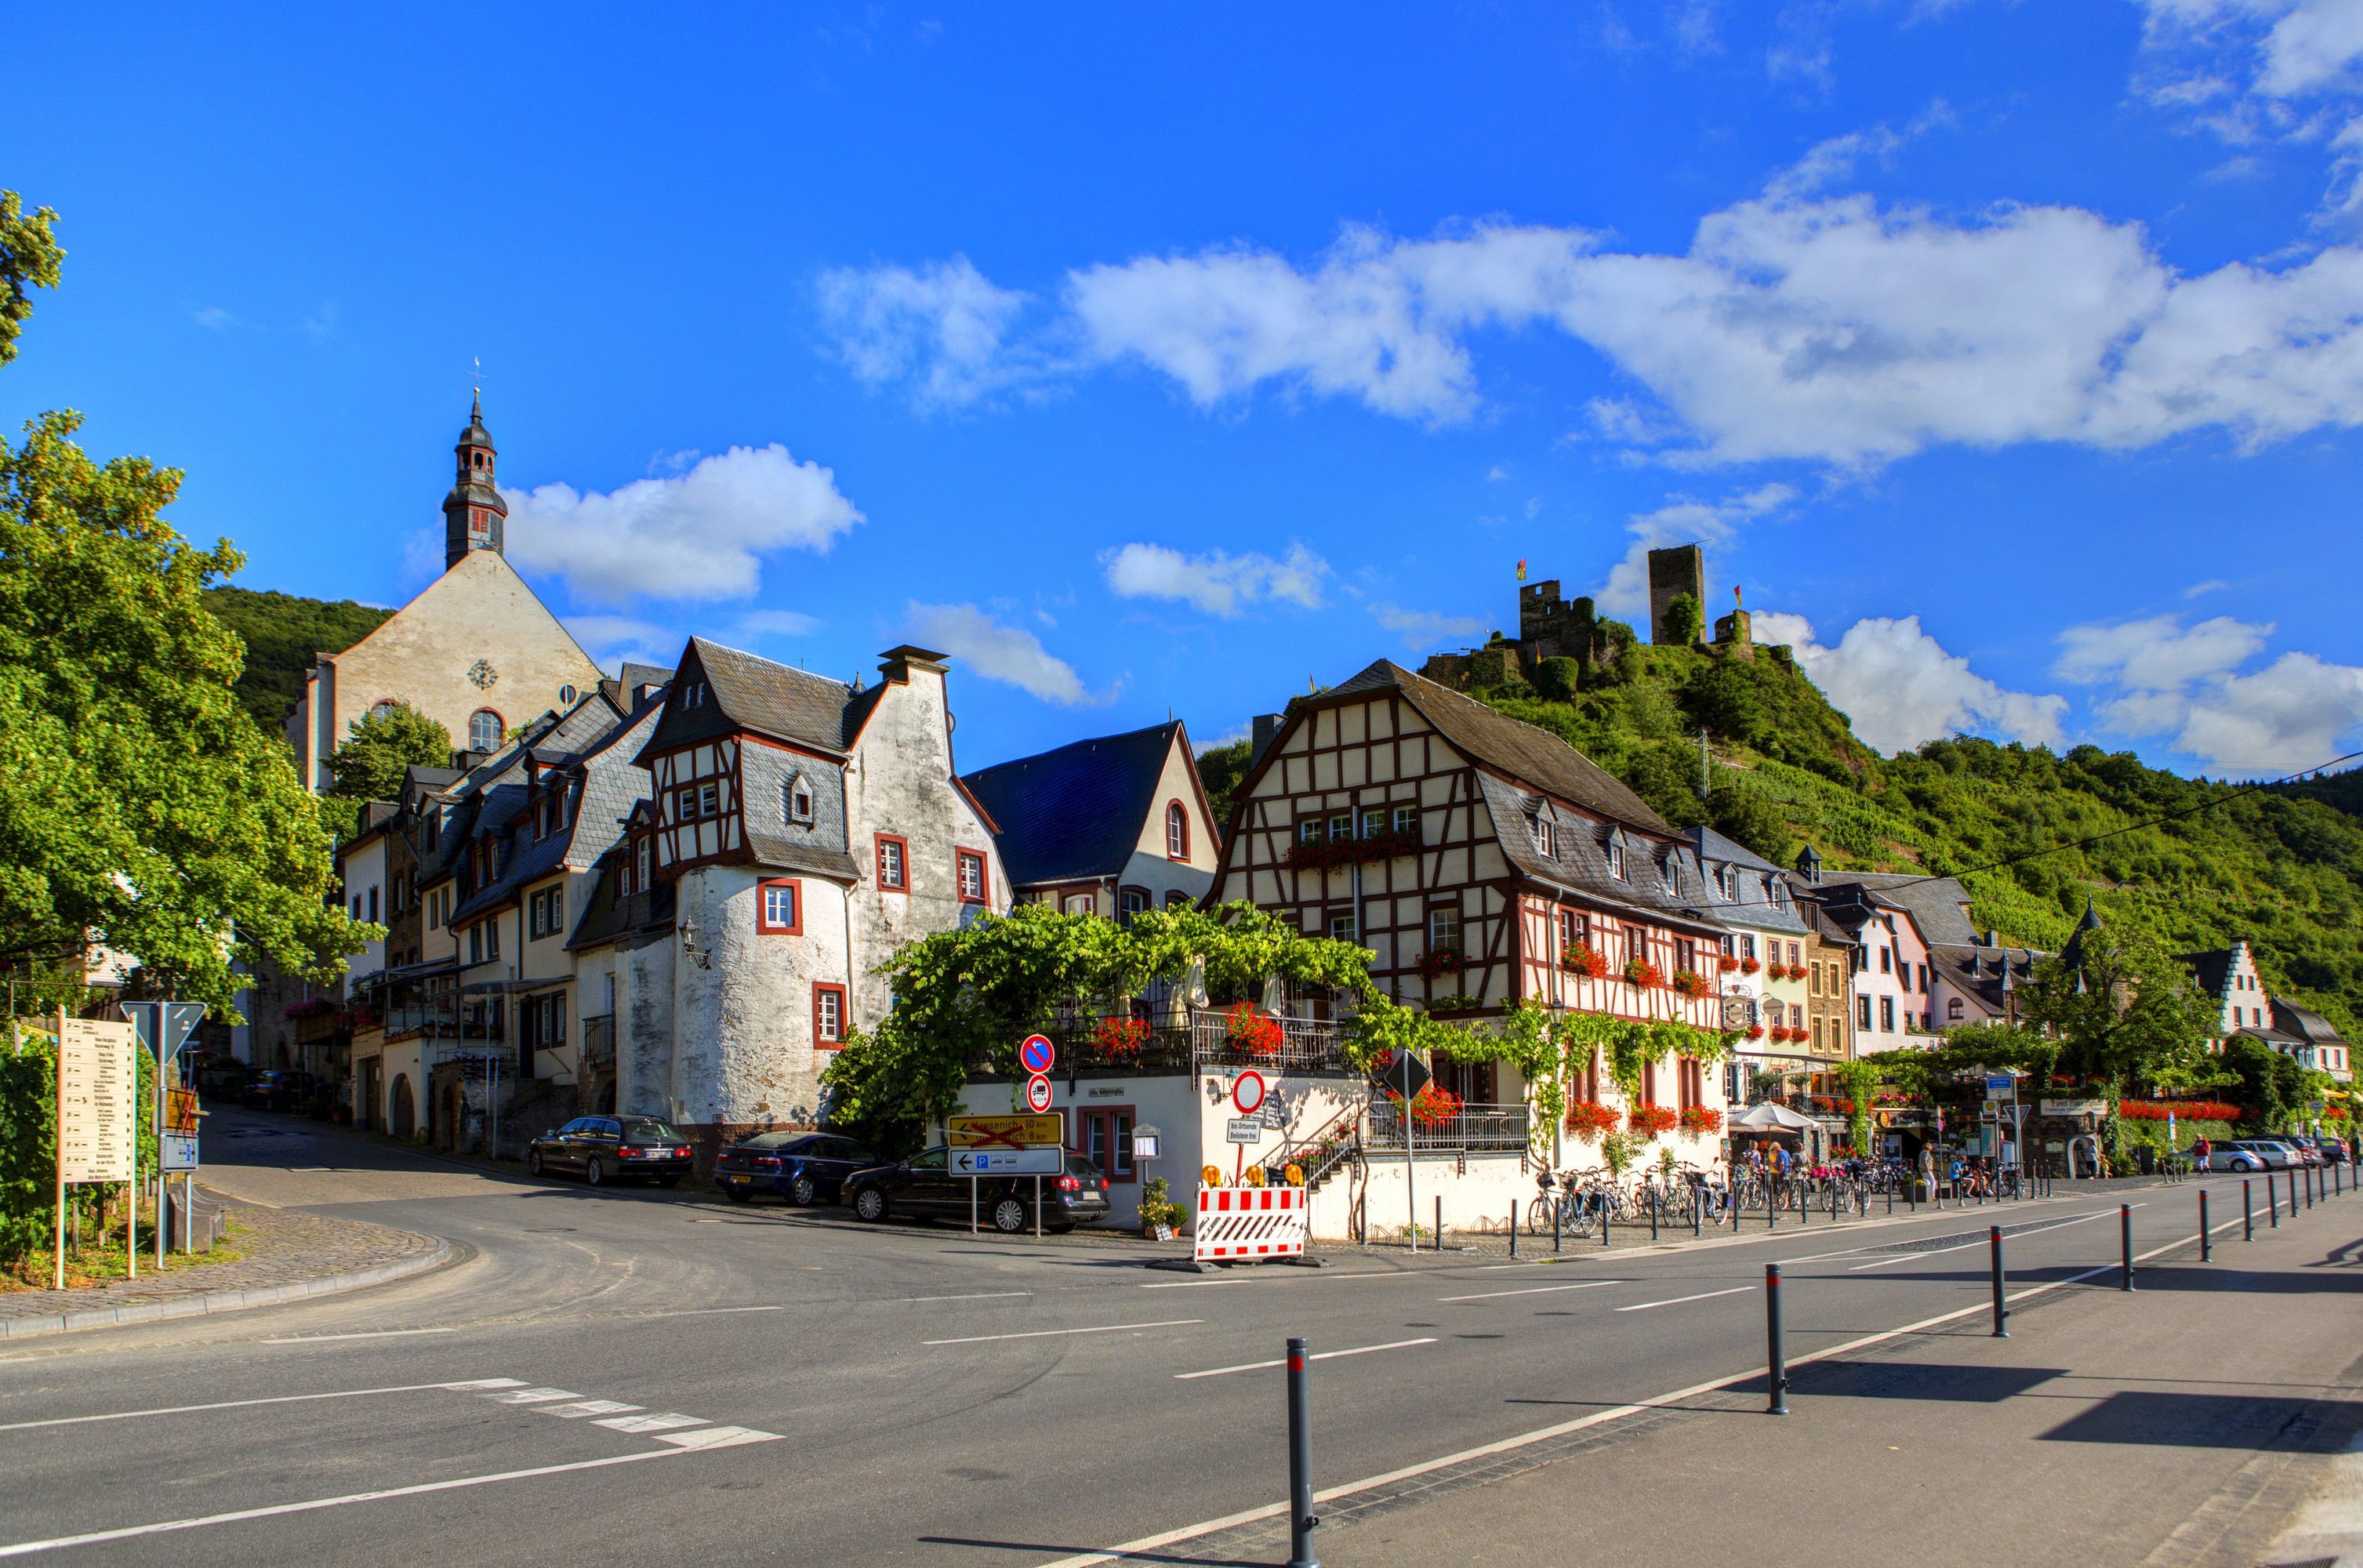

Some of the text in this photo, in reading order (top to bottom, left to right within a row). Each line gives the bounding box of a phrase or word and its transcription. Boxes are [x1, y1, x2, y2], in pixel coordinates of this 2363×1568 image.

[975, 1120, 1018, 1130] iesenich
[1025, 1119, 1034, 1129] 10
[1029, 1131, 1035, 1140] 8
[979, 1156, 985, 1167] P
